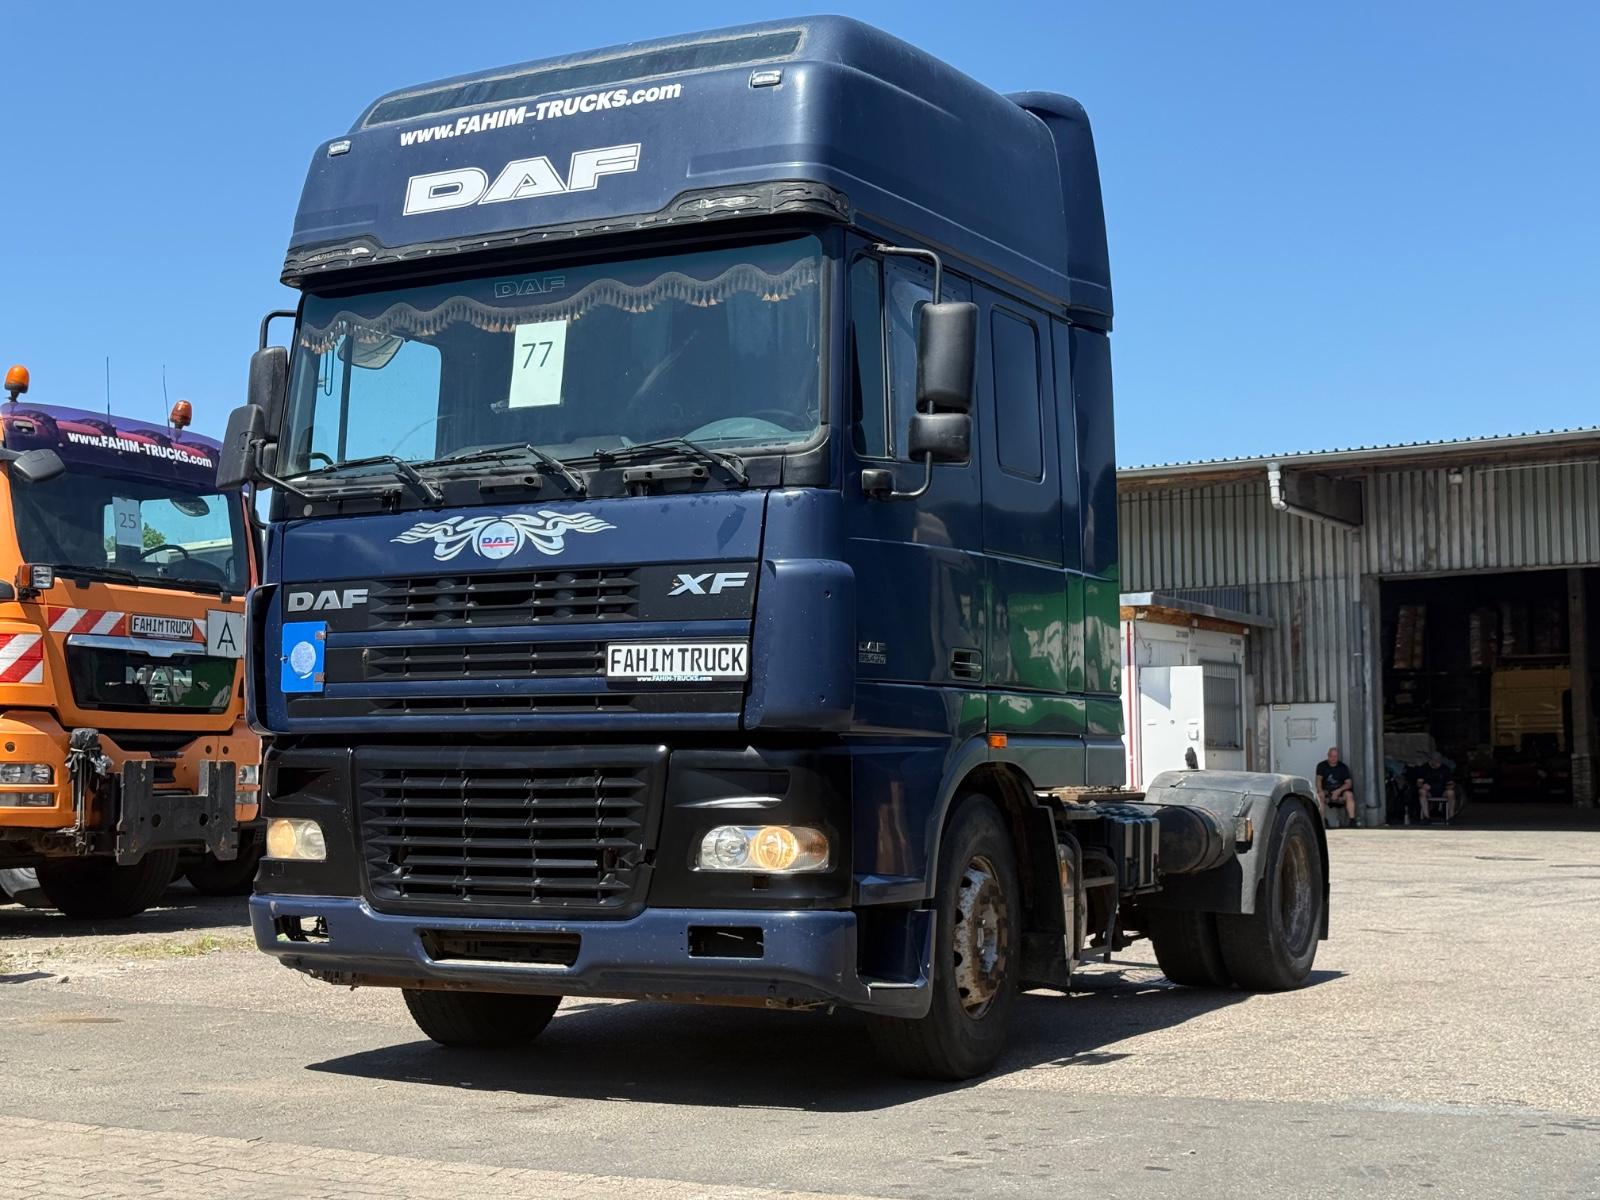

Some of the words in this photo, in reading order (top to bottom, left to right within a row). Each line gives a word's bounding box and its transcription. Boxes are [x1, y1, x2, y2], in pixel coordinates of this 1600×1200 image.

[400, 83, 682, 146] www.FAHIM-TRUCKS.com
[403, 143, 642, 216] DAF
[494, 275, 566, 298] DAF
[522, 341, 553, 369] 77
[67, 432, 213, 468] www.FAHIM-TRUCKS.com
[119, 512, 137, 529] 25
[482, 536, 516, 544] DAF
[667, 571, 750, 596] XF
[287, 588, 369, 612] DAF
[133, 617, 192, 635] FAHIMTRUCK
[216, 620, 237, 652] A
[610, 647, 744, 673] FAHIMTRUCK
[125, 665, 193, 688] MAN
